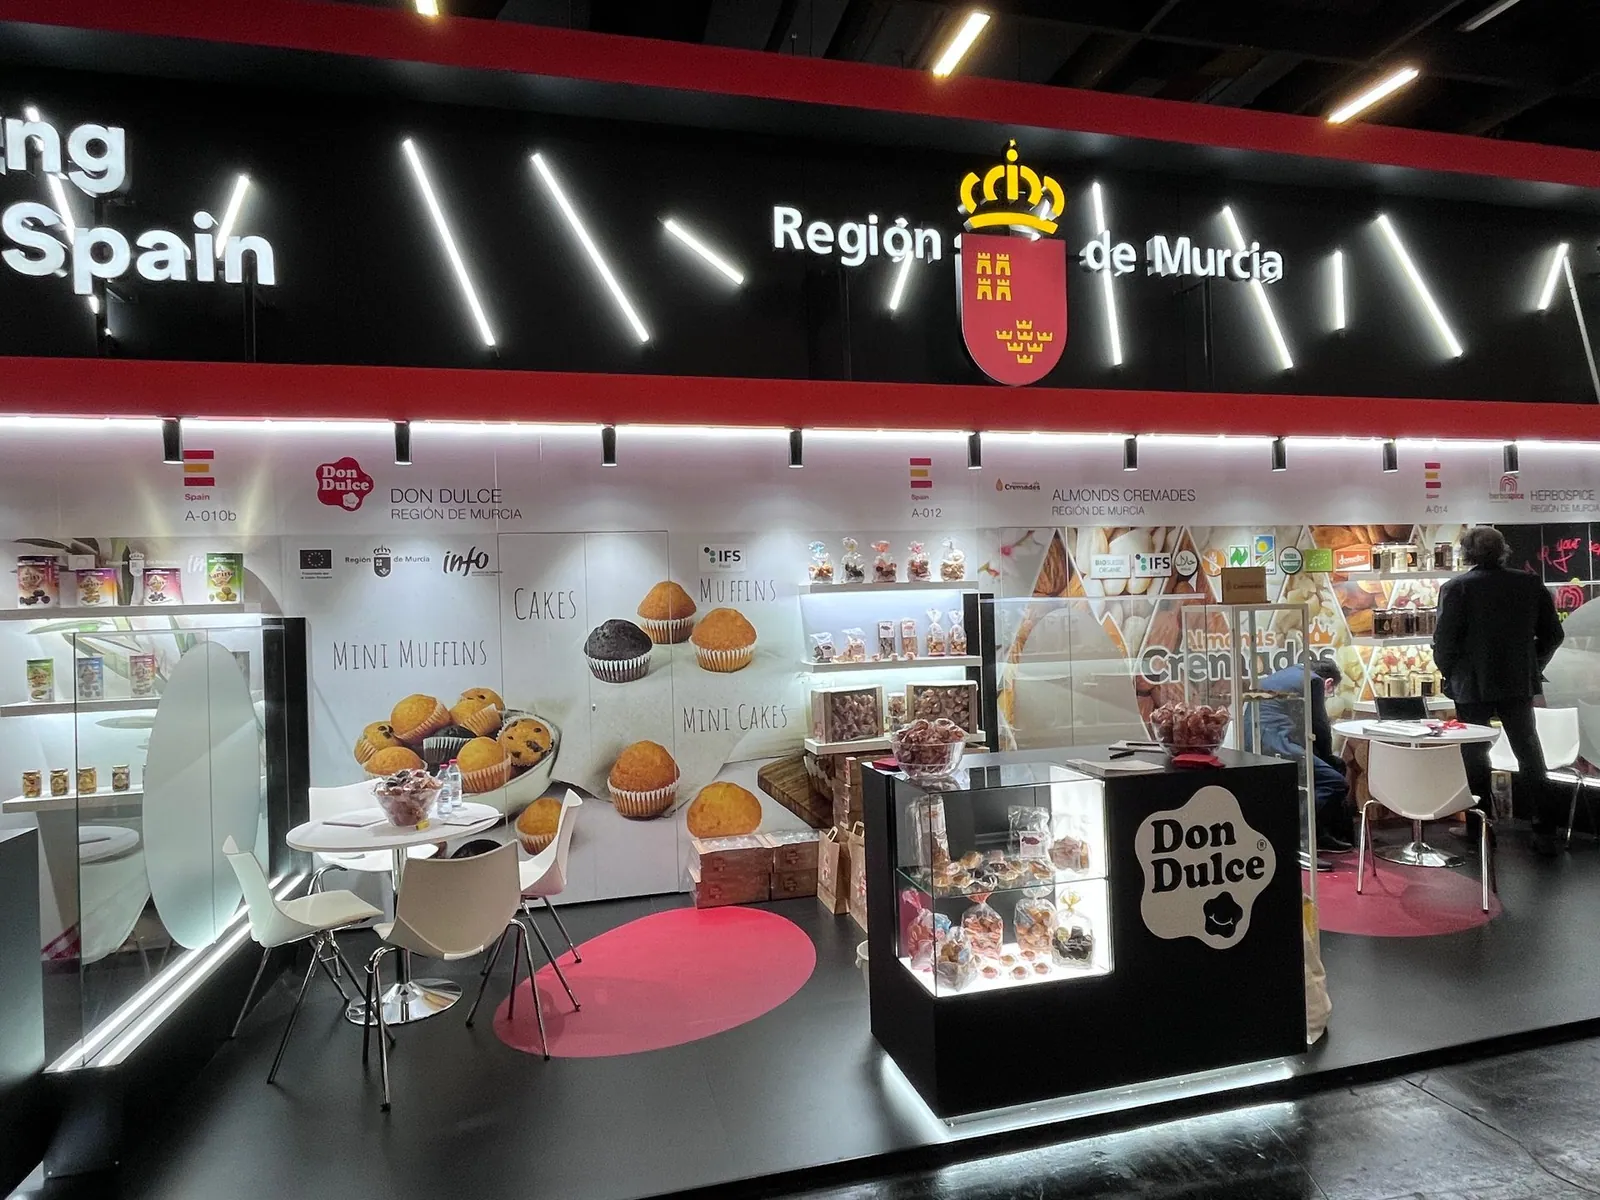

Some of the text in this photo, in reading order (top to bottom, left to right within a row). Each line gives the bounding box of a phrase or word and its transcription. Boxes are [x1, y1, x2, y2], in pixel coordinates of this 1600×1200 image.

[2, 202, 275, 294] Spain
[773, 205, 1283, 279] Región de Murcia
[322, 465, 357, 479] Don
[322, 478, 370, 492] Dulce
[184, 493, 210, 502] Spain
[390, 488, 503, 504] DON DULCE
[1052, 488, 1196, 502] ALMONDS CREMADES
[184, 509, 237, 522] A-010b
[391, 506, 523, 520] REGIÓN DE MURCIA
[911, 508, 942, 518] A-012
[1052, 504, 1145, 516] REGIÓN DE MURCIA
[345, 556, 371, 564] Región
[443, 546, 489, 577] info
[719, 550, 741, 562] IFS
[1149, 557, 1170, 569] IFS
[1151, 819, 1237, 854] Don
[1151, 852, 1265, 894] Dulce
